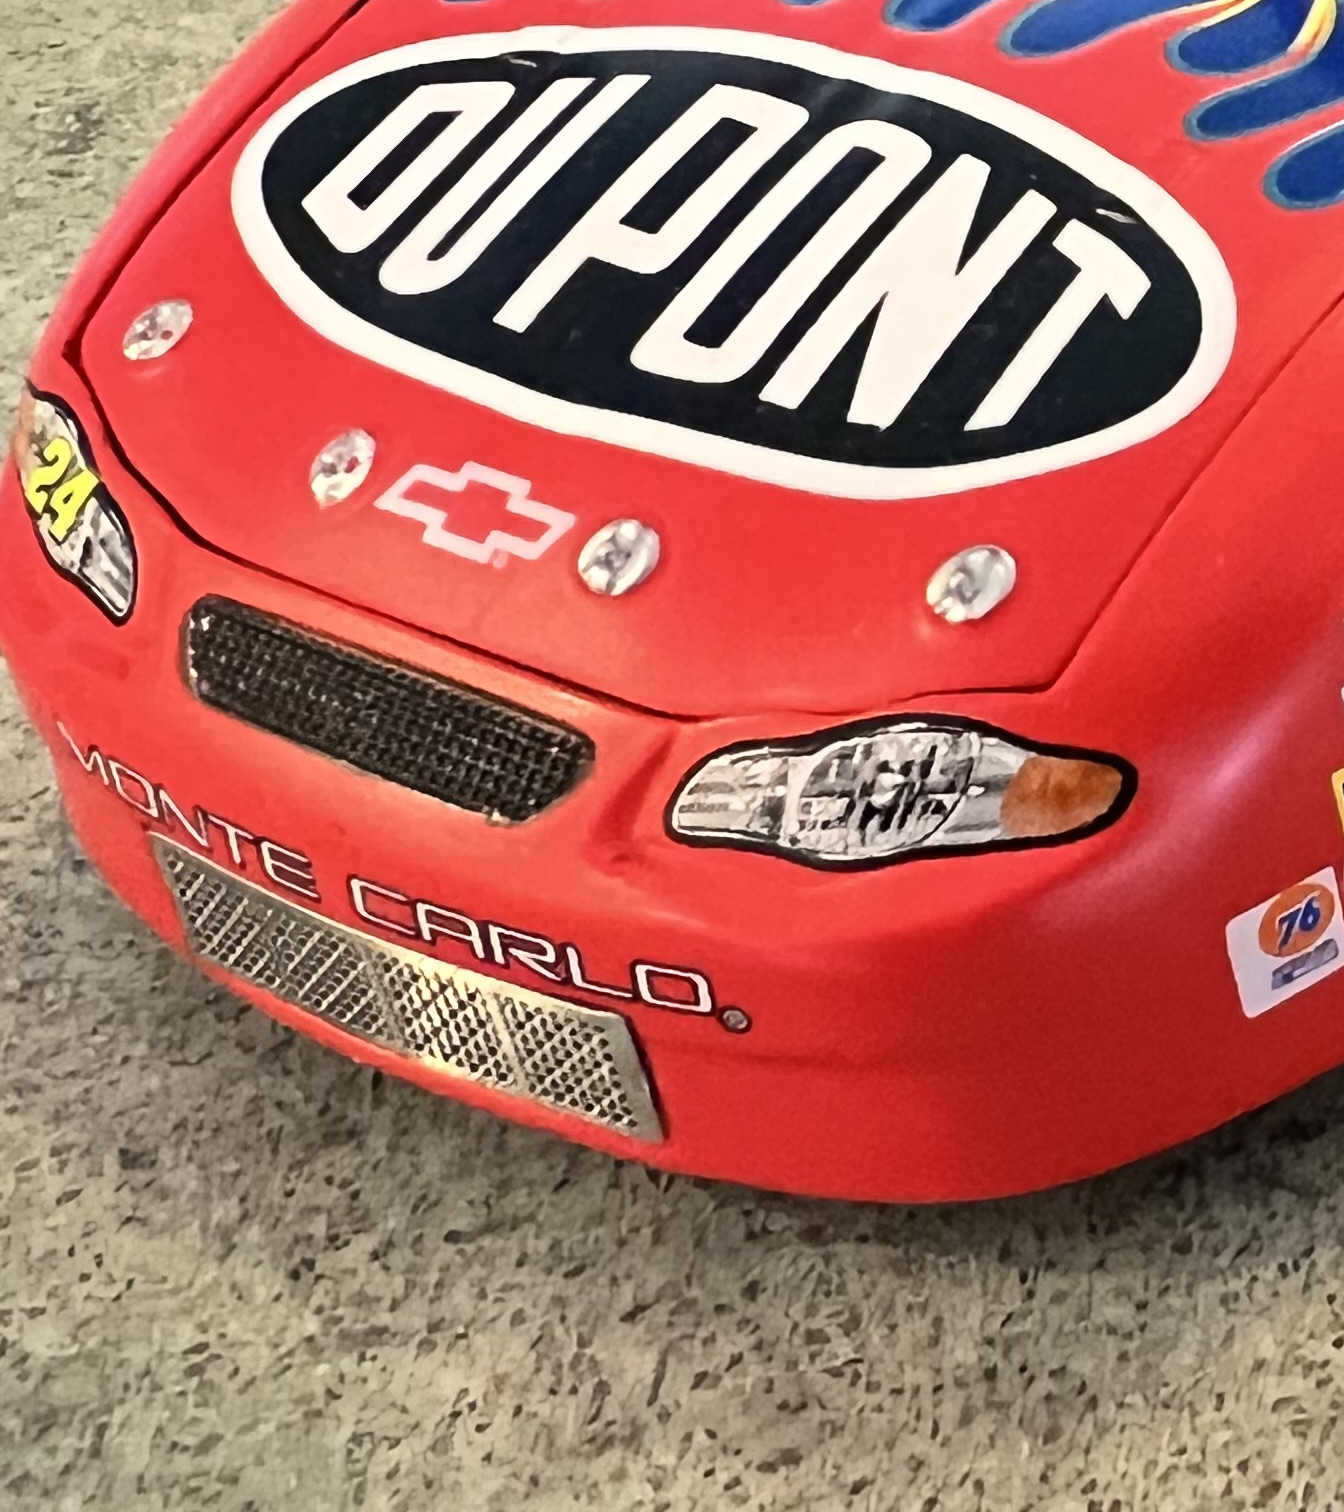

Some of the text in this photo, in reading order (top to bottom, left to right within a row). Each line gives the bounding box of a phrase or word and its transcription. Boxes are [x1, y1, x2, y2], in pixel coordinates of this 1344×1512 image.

[24, 436, 101, 542] 24
[56, 720, 716, 1017] MONTE CARLO
[1276, 891, 1322, 956] 76
